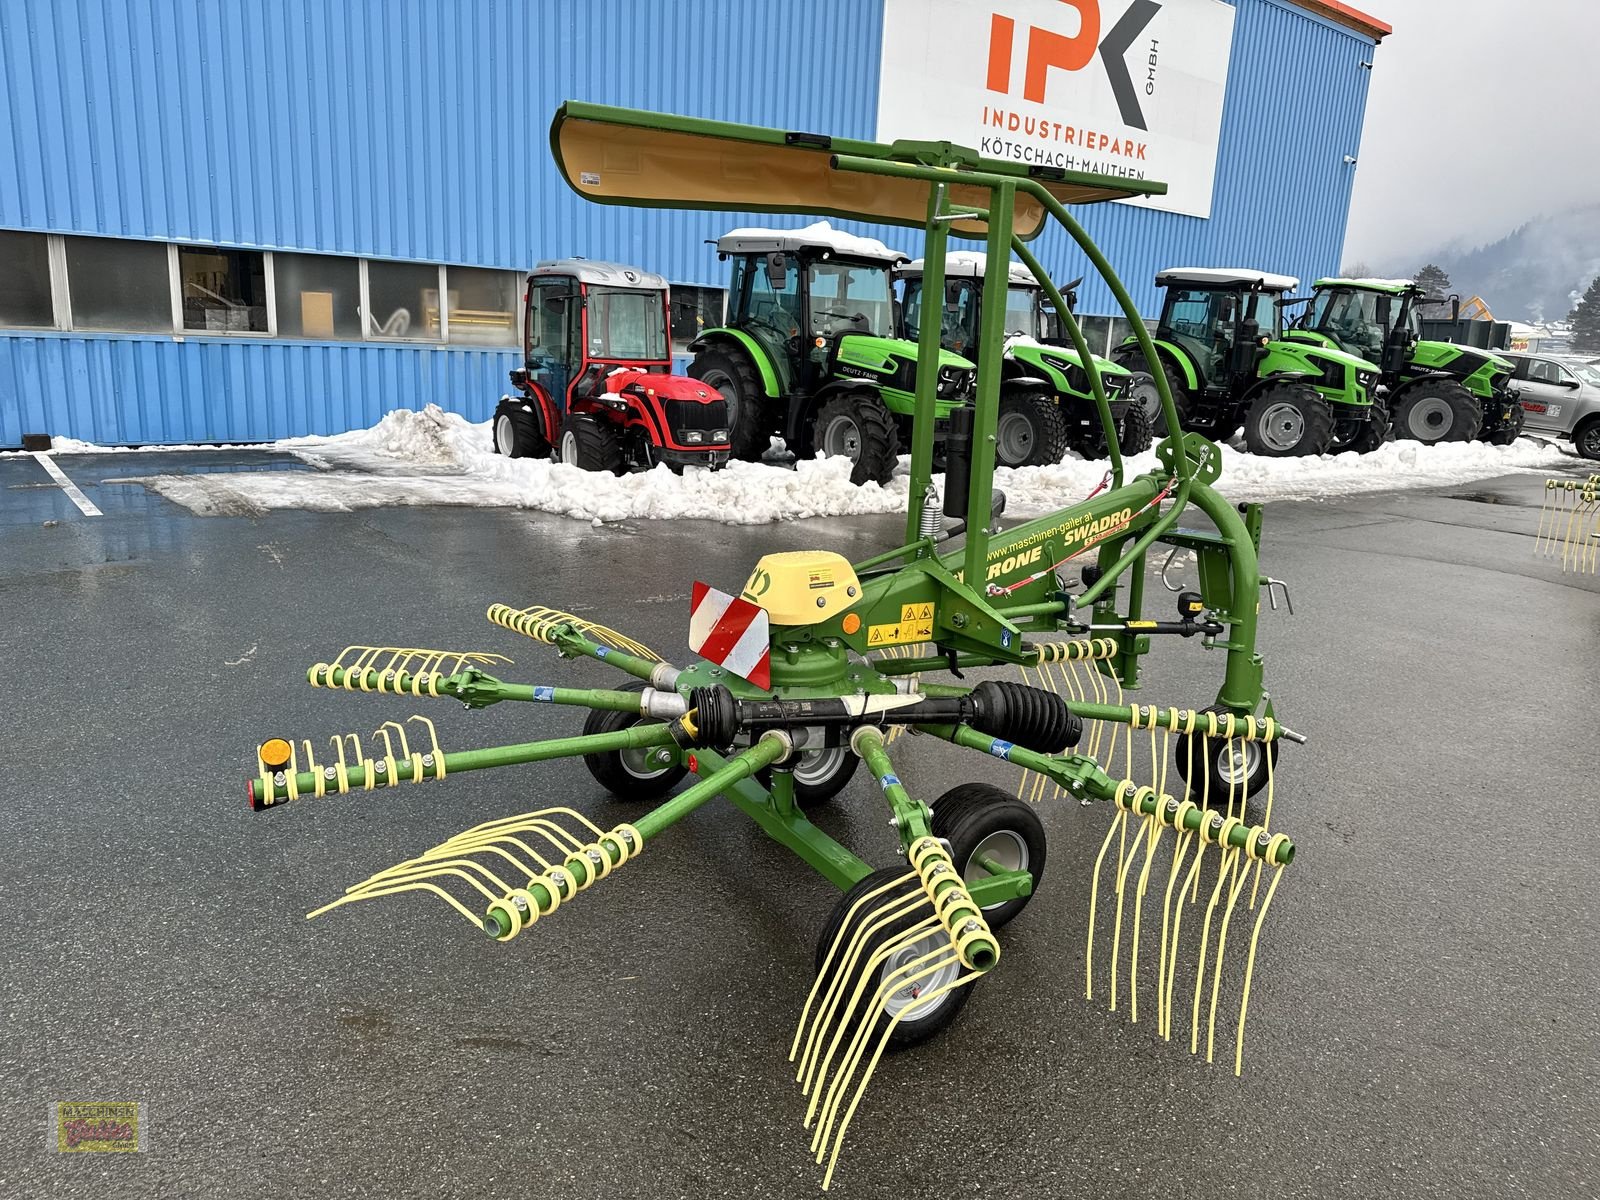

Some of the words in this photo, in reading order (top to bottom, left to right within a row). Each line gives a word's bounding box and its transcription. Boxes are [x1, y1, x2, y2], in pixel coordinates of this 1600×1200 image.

[986, 0, 1163, 131] IPK
[1145, 39, 1159, 96] GMBH
[983, 106, 1147, 161] INDUSTRIEPARK
[986, 511, 1094, 562] www.maschinen-gailer.at
[1063, 507, 1132, 547] SWADRO
[985, 545, 1043, 582] RONE
